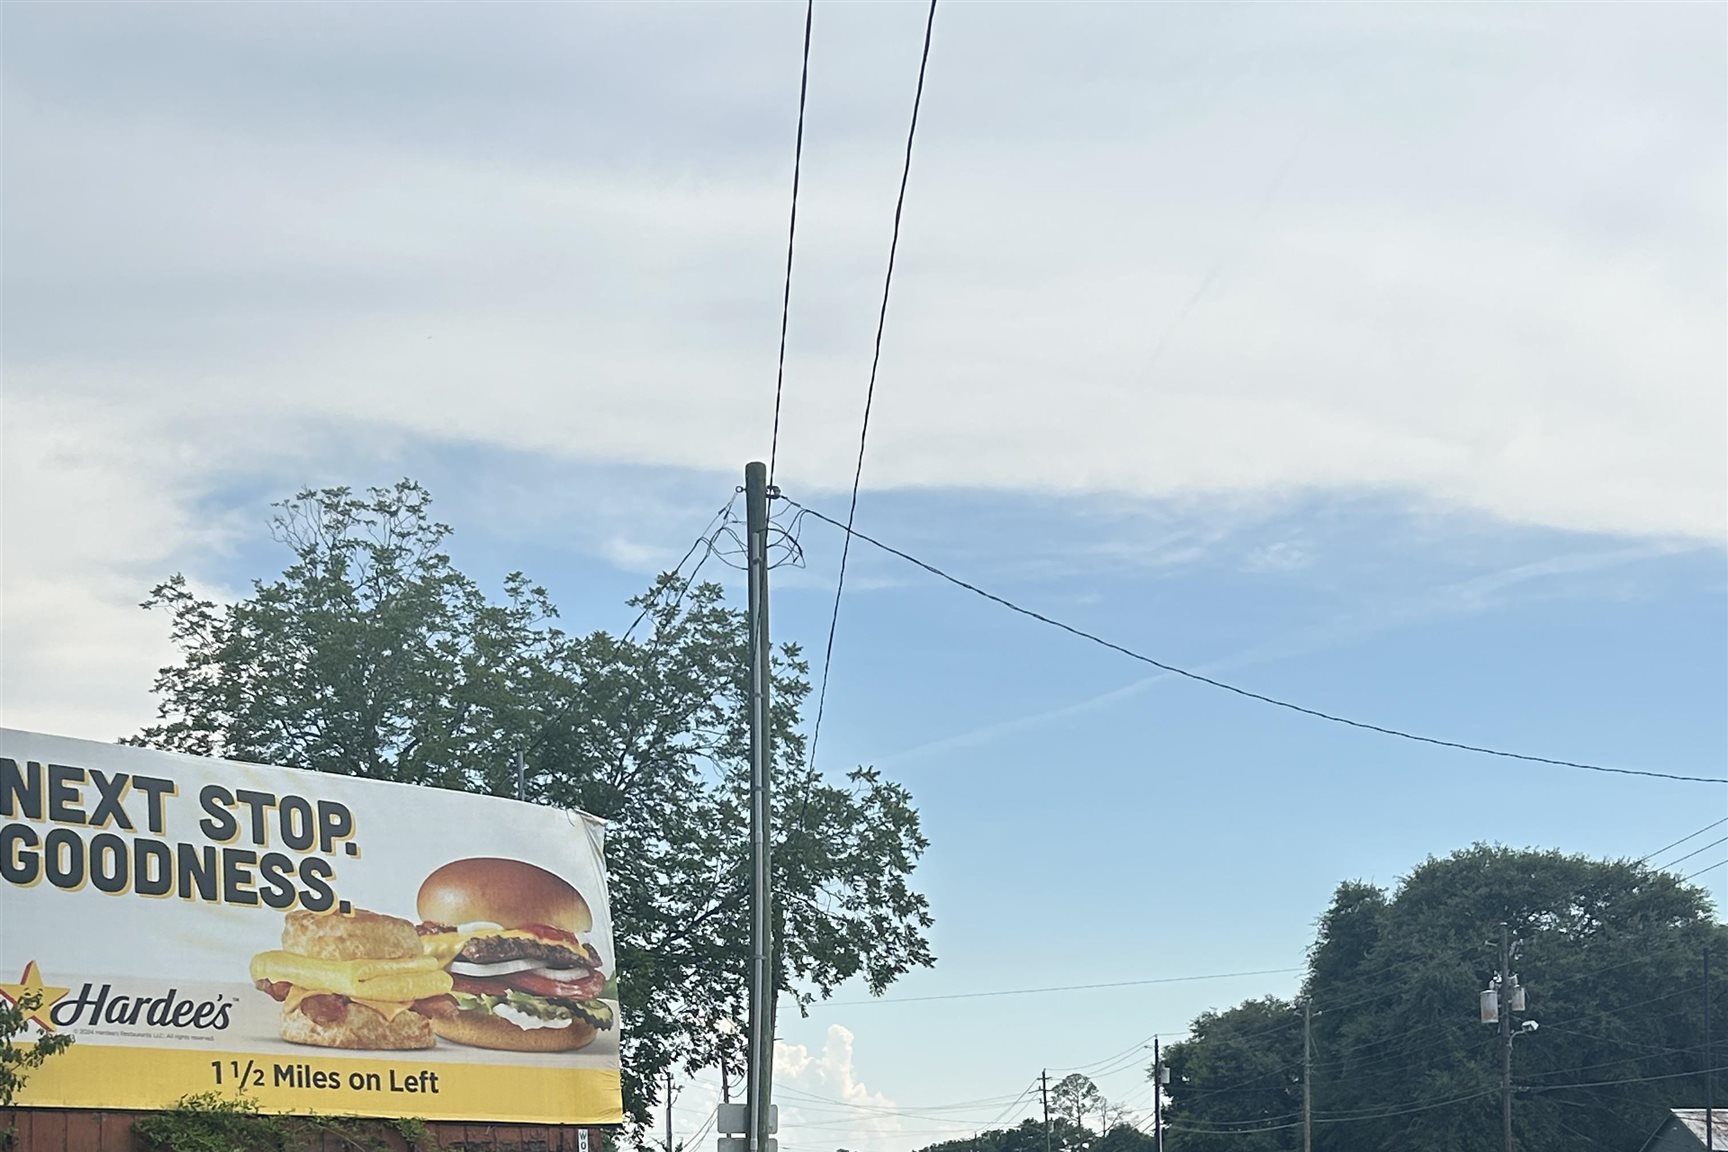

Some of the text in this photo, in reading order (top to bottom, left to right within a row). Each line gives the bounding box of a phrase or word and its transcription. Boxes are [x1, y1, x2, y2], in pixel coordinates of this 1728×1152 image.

[0, 757, 361, 860] NEXT STOP.
[0, 823, 356, 918] GOODNESS.
[50, 982, 233, 1030] Hardee's
[211, 1060, 222, 1085] 1
[273, 1063, 341, 1090] Miles
[348, 1072, 381, 1092] on
[389, 1069, 440, 1095] Left
